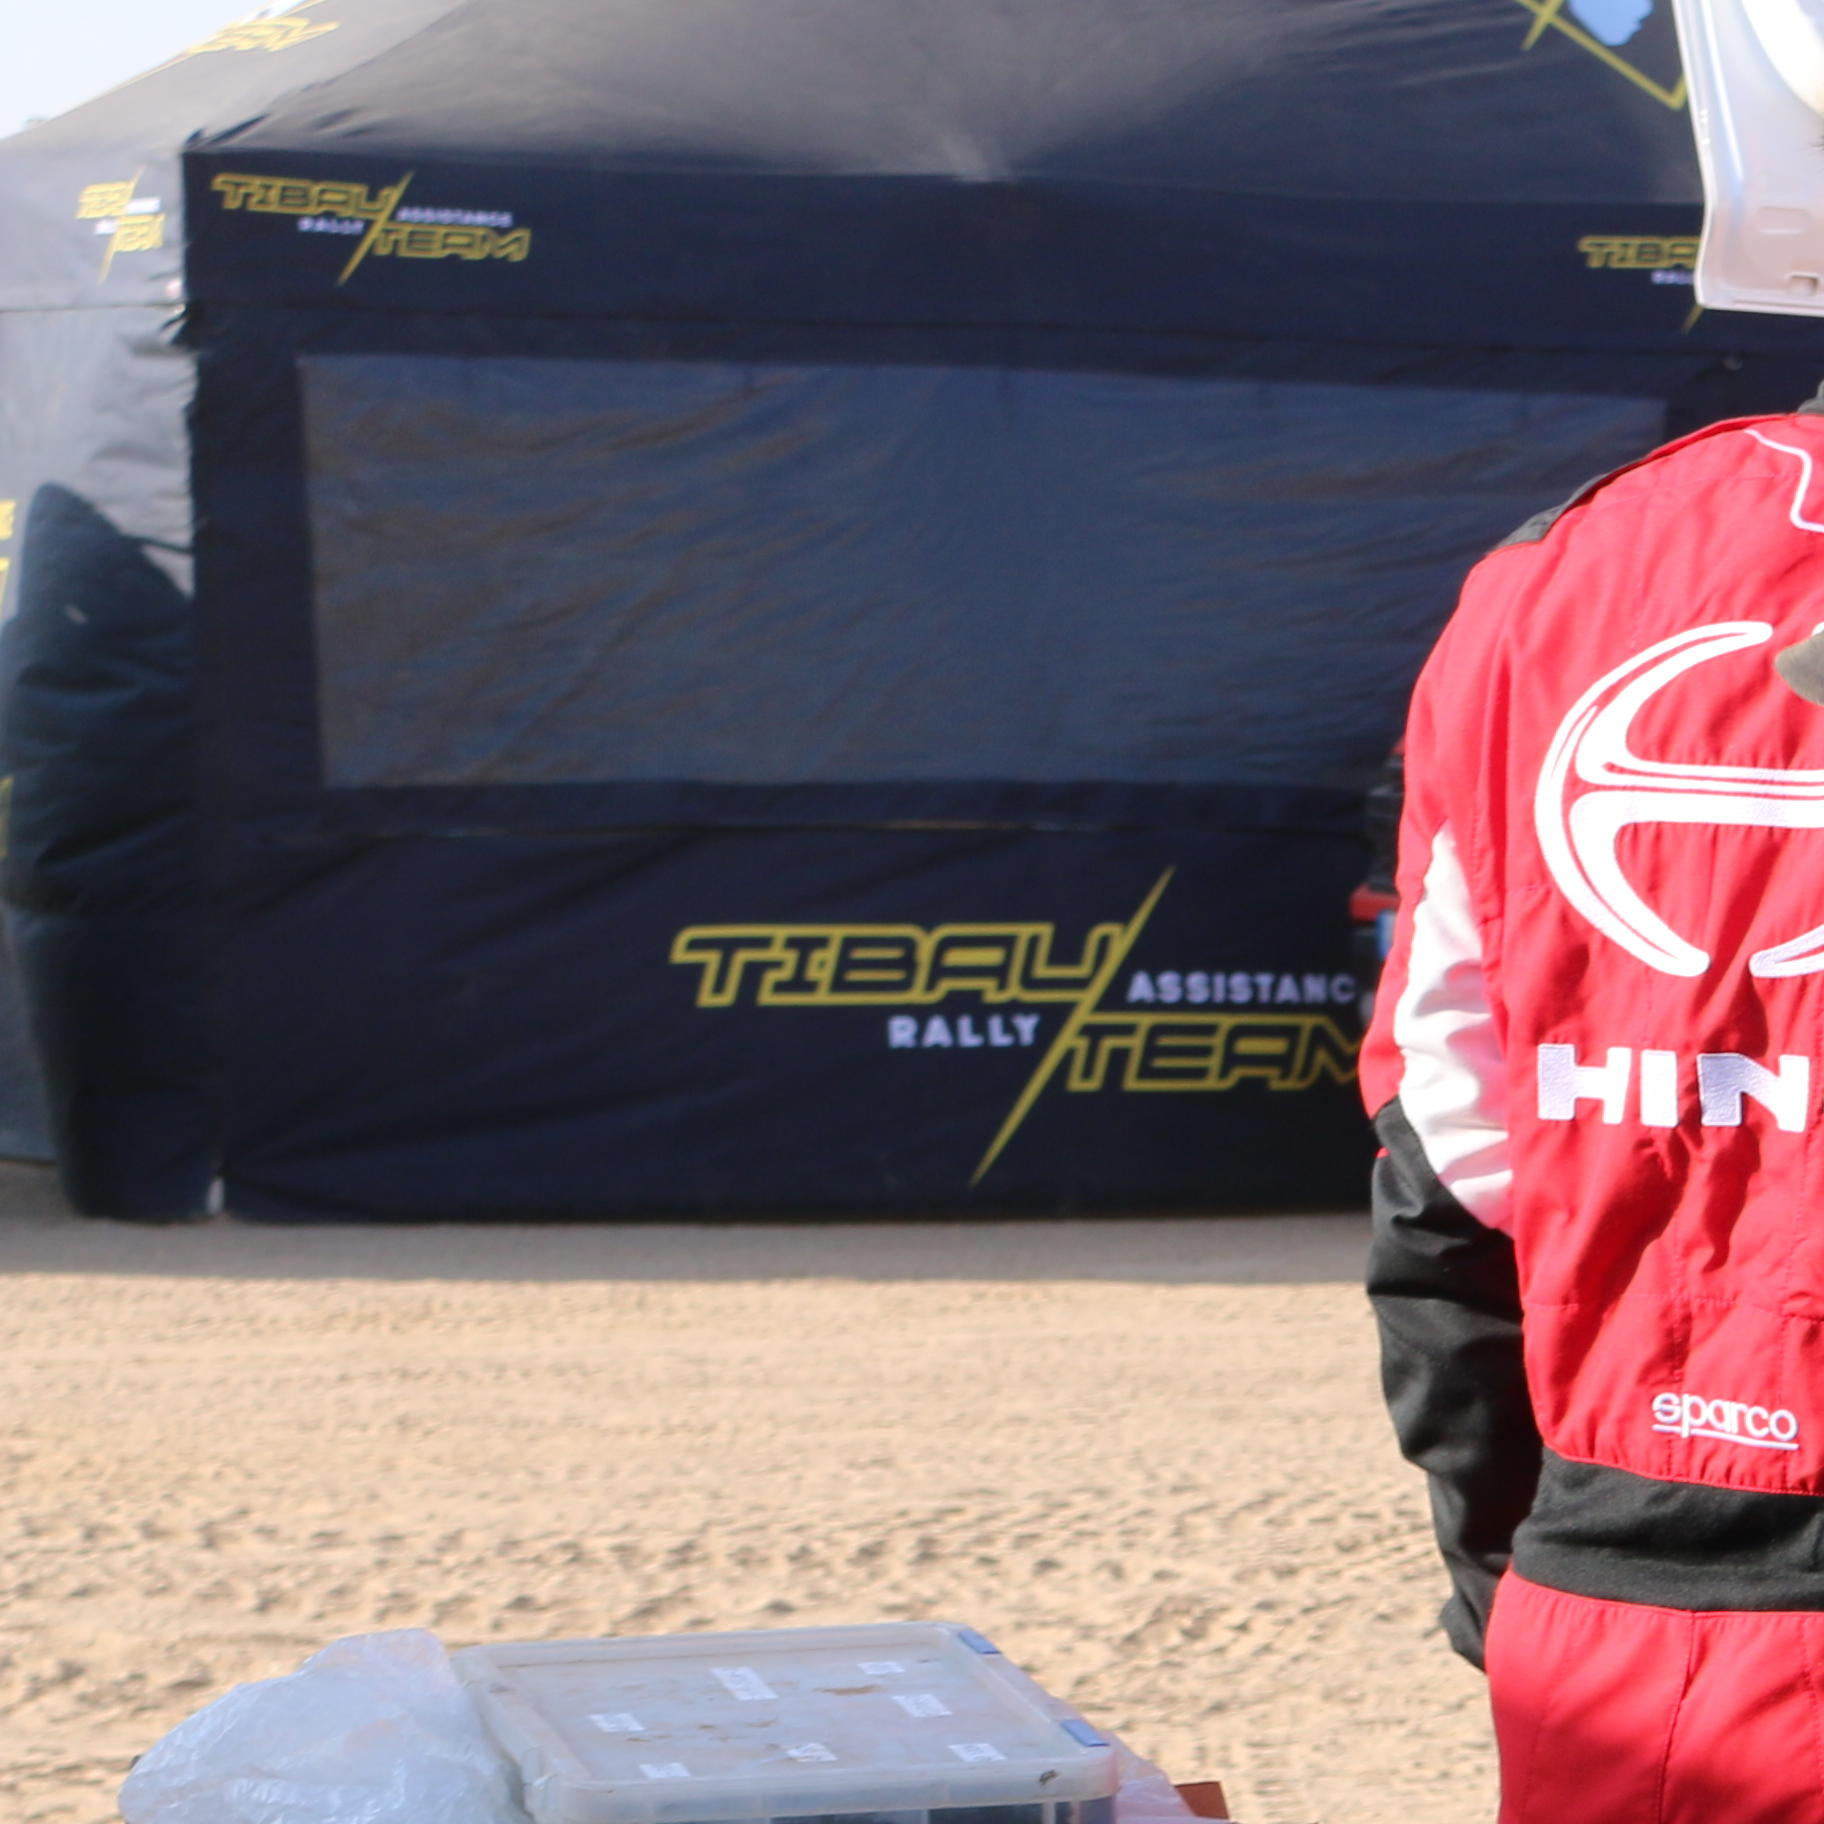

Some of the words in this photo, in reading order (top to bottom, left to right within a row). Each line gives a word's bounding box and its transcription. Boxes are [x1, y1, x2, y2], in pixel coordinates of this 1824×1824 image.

[372, 221, 533, 262] TEAM
[1577, 236, 1702, 269] TIBA
[668, 922, 1128, 1008] TIBAU
[888, 1014, 1041, 1049] RALLY
[1650, 1390, 1800, 1441] sparco
